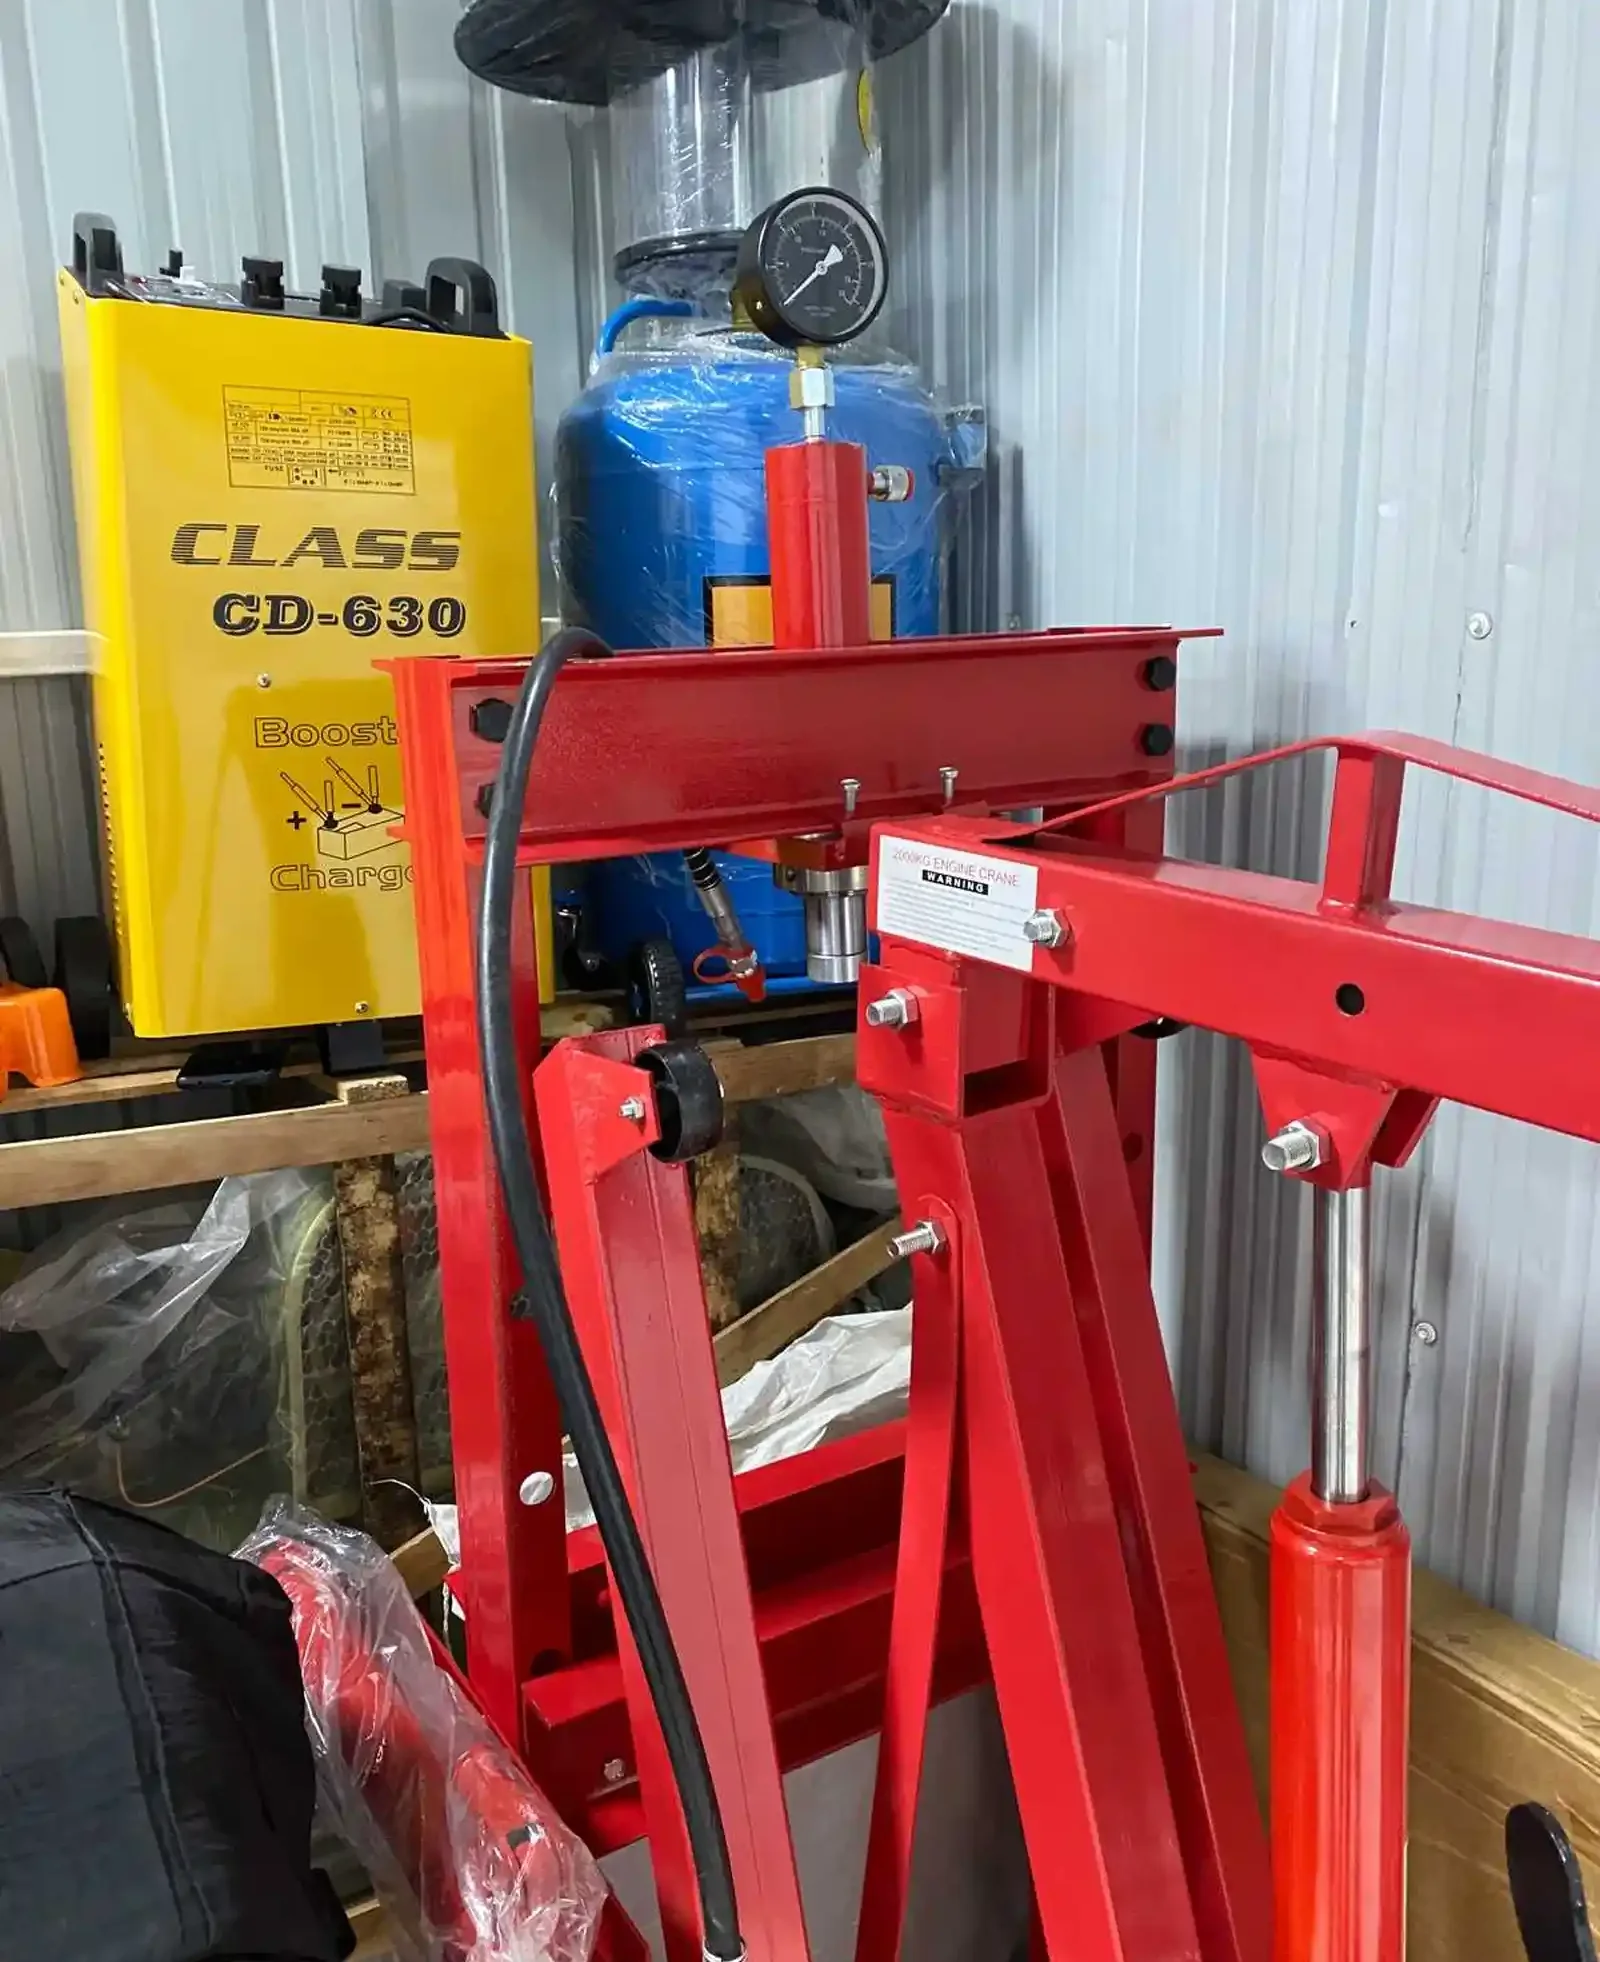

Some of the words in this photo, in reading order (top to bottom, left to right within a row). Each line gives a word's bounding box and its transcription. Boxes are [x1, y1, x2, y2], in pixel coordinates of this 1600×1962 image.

[170, 522, 462, 571] CLASS
[213, 593, 467, 638] CD-630
[926, 871, 985, 894] WARNING
[933, 857, 977, 878] ENGINE
[978, 867, 1021, 888] CRANE
